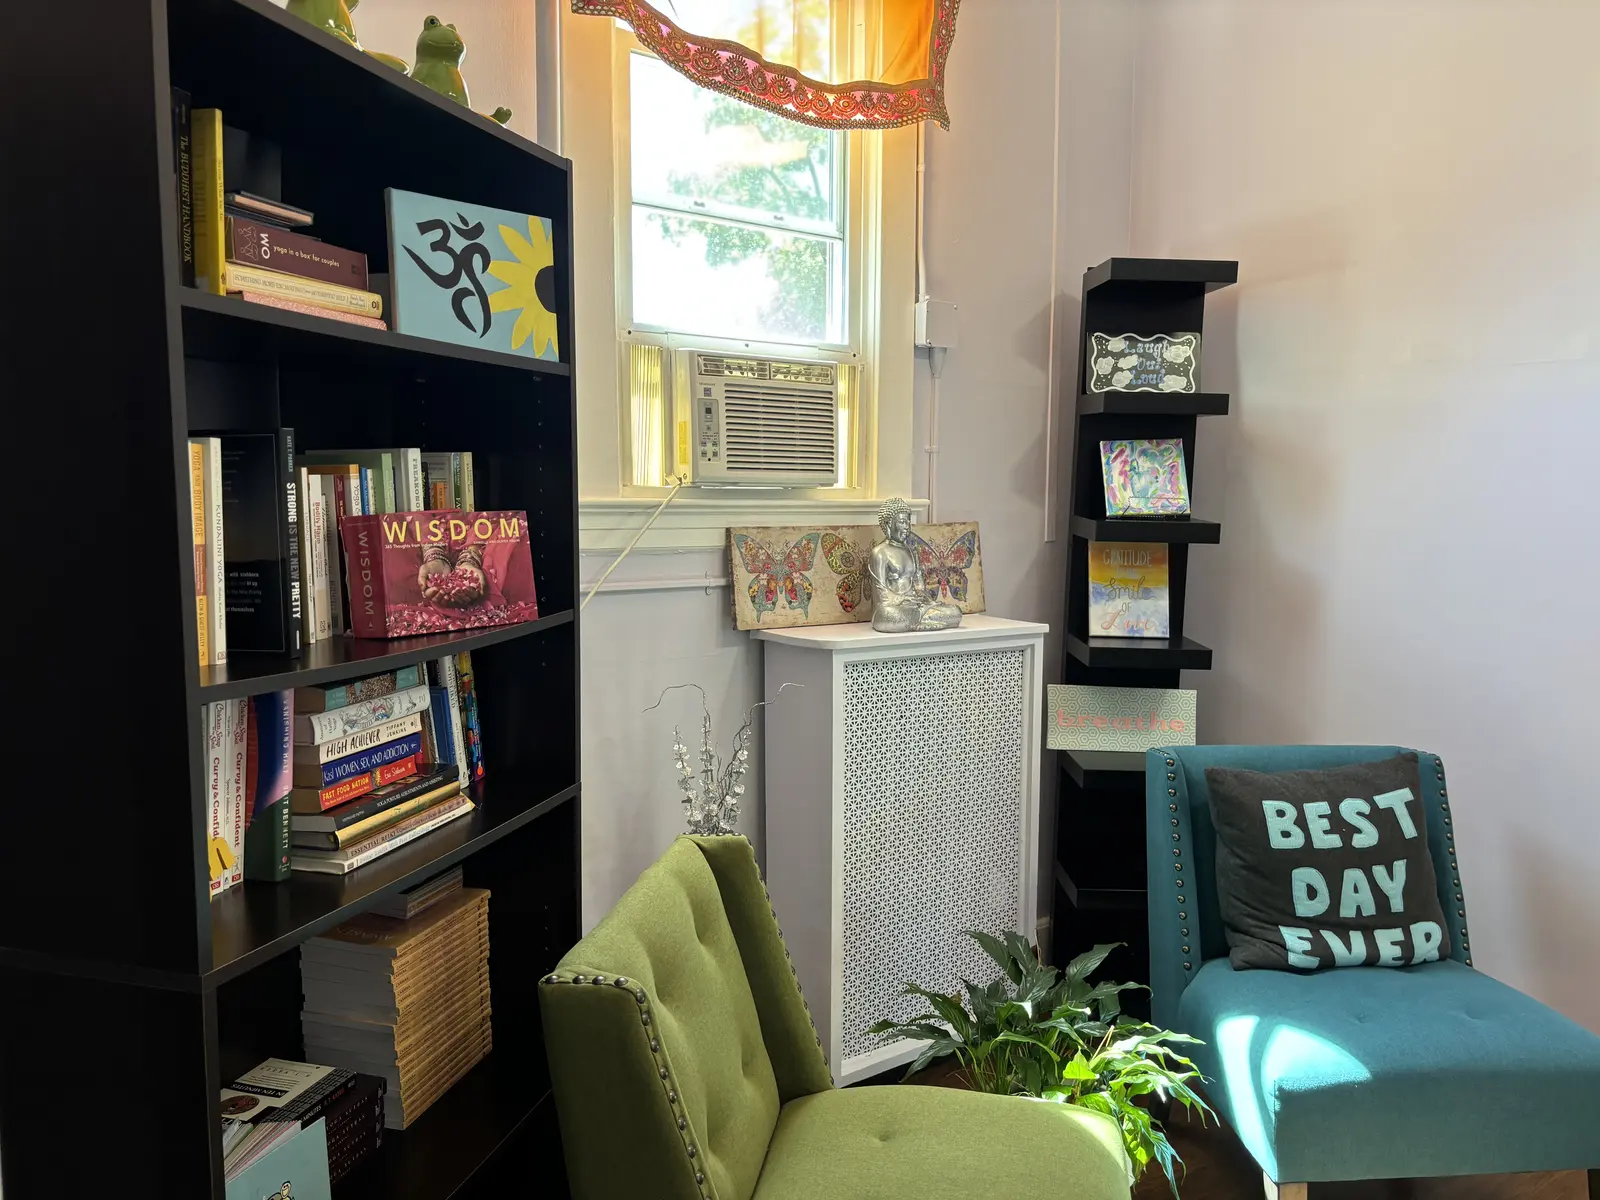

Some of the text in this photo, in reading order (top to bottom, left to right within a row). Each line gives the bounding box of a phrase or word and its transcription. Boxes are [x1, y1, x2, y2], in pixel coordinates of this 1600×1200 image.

[180, 152, 190, 203] BUDDHIST
[182, 204, 192, 263] HANDBOOK
[259, 232, 271, 260] OM
[273, 244, 288, 256] yoga
[288, 249, 294, 257] in
[312, 253, 321, 263] for
[321, 257, 341, 268] couples
[1123, 339, 1170, 358] Laugh
[1130, 369, 1165, 385] Loud
[192, 450, 201, 471] YOGA
[352, 485, 360, 506] Yoga
[412, 458, 420, 512] FREAKONO
[194, 489, 202, 511] BODY
[194, 512, 203, 537] IMAGE
[383, 518, 520, 543] WISDOM
[286, 482, 301, 619] STRONG IS THE NEW PRETTY
[1103, 547, 1153, 567] GRATITUDE
[357, 530, 376, 616] WISDOM
[1103, 575, 1157, 602] Smile
[447, 673, 457, 709] DISLIKED
[282, 698, 290, 748] VANISHING
[386, 721, 406, 732] TIFFANY
[386, 728, 407, 738] JENKINS
[1057, 707, 1185, 733] breathe
[326, 728, 381, 758] HIGH ACHIEVER
[371, 753, 383, 766] AND
[383, 743, 409, 761] ADDICTION
[212, 757, 221, 841] Curvy & Confid
[234, 752, 243, 848] Curvy & Confident
[322, 788, 335, 800] FAST
[336, 783, 351, 794] FOOD
[351, 775, 369, 789] NATION
[1262, 787, 1418, 849] BEST
[350, 838, 380, 857] ESSENTIAL
[381, 831, 396, 842] REIKI
[1291, 858, 1408, 918] DAY
[1278, 920, 1443, 970] EVER
[230, 1083, 263, 1093] MINUTES
